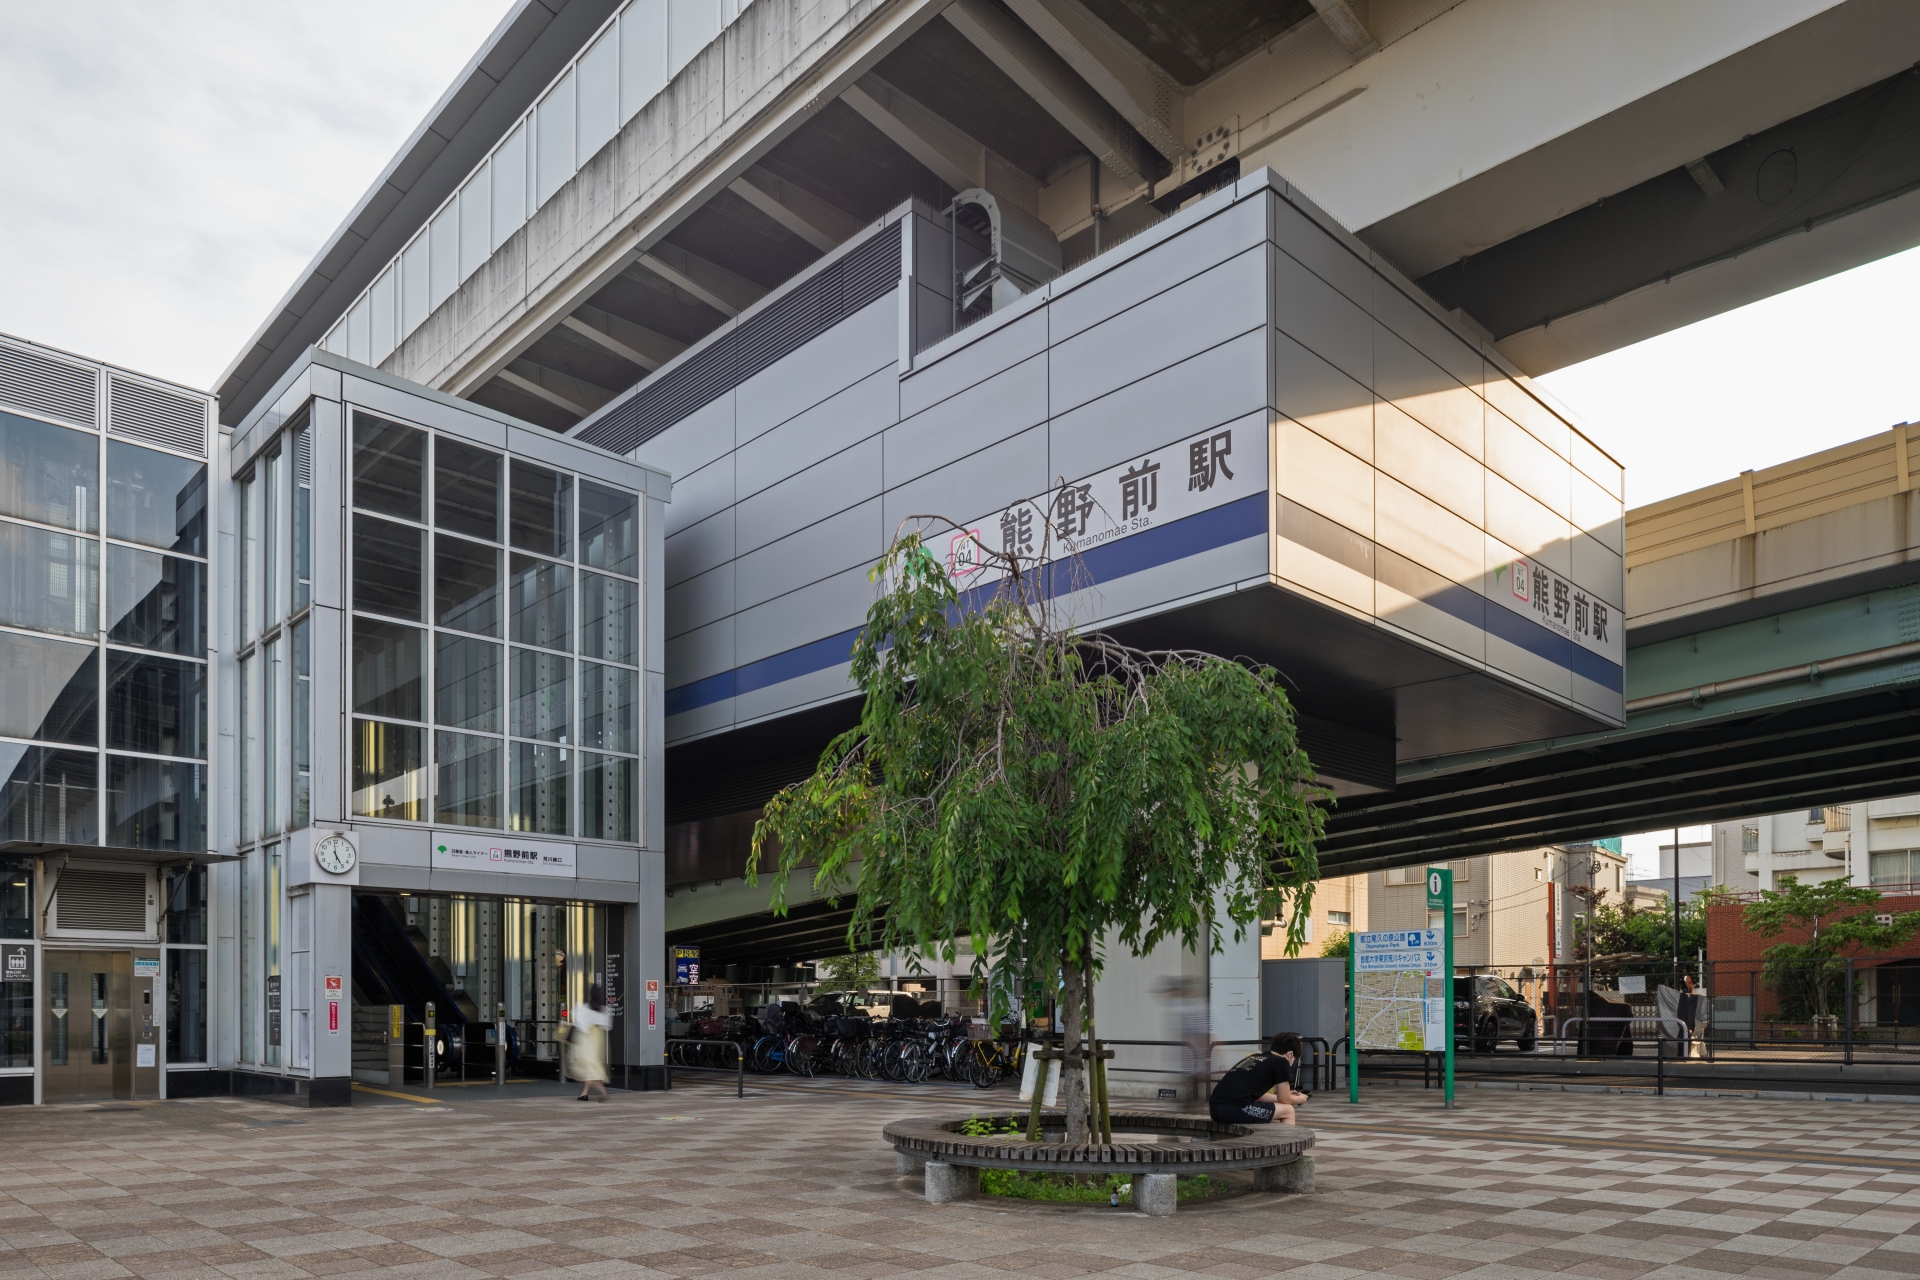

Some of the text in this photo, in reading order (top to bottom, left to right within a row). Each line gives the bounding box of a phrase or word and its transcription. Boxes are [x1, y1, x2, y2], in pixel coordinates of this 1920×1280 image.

[1000, 429, 1234, 563] 熊野前駅
[1063, 515, 1153, 553] Kumanomae Sta.
[958, 549, 973, 567] 04
[1516, 576, 1525, 592] 04
[1533, 565, 1608, 644] 熊野前駅
[1542, 614, 1582, 643] Kumanomae Sta.
[504, 849, 538, 860] 熊野前駅
[1360, 933, 1405, 944] 都立尾久の原公園
[1360, 953, 1421, 964] 首都大学東京荒川キャンパス
